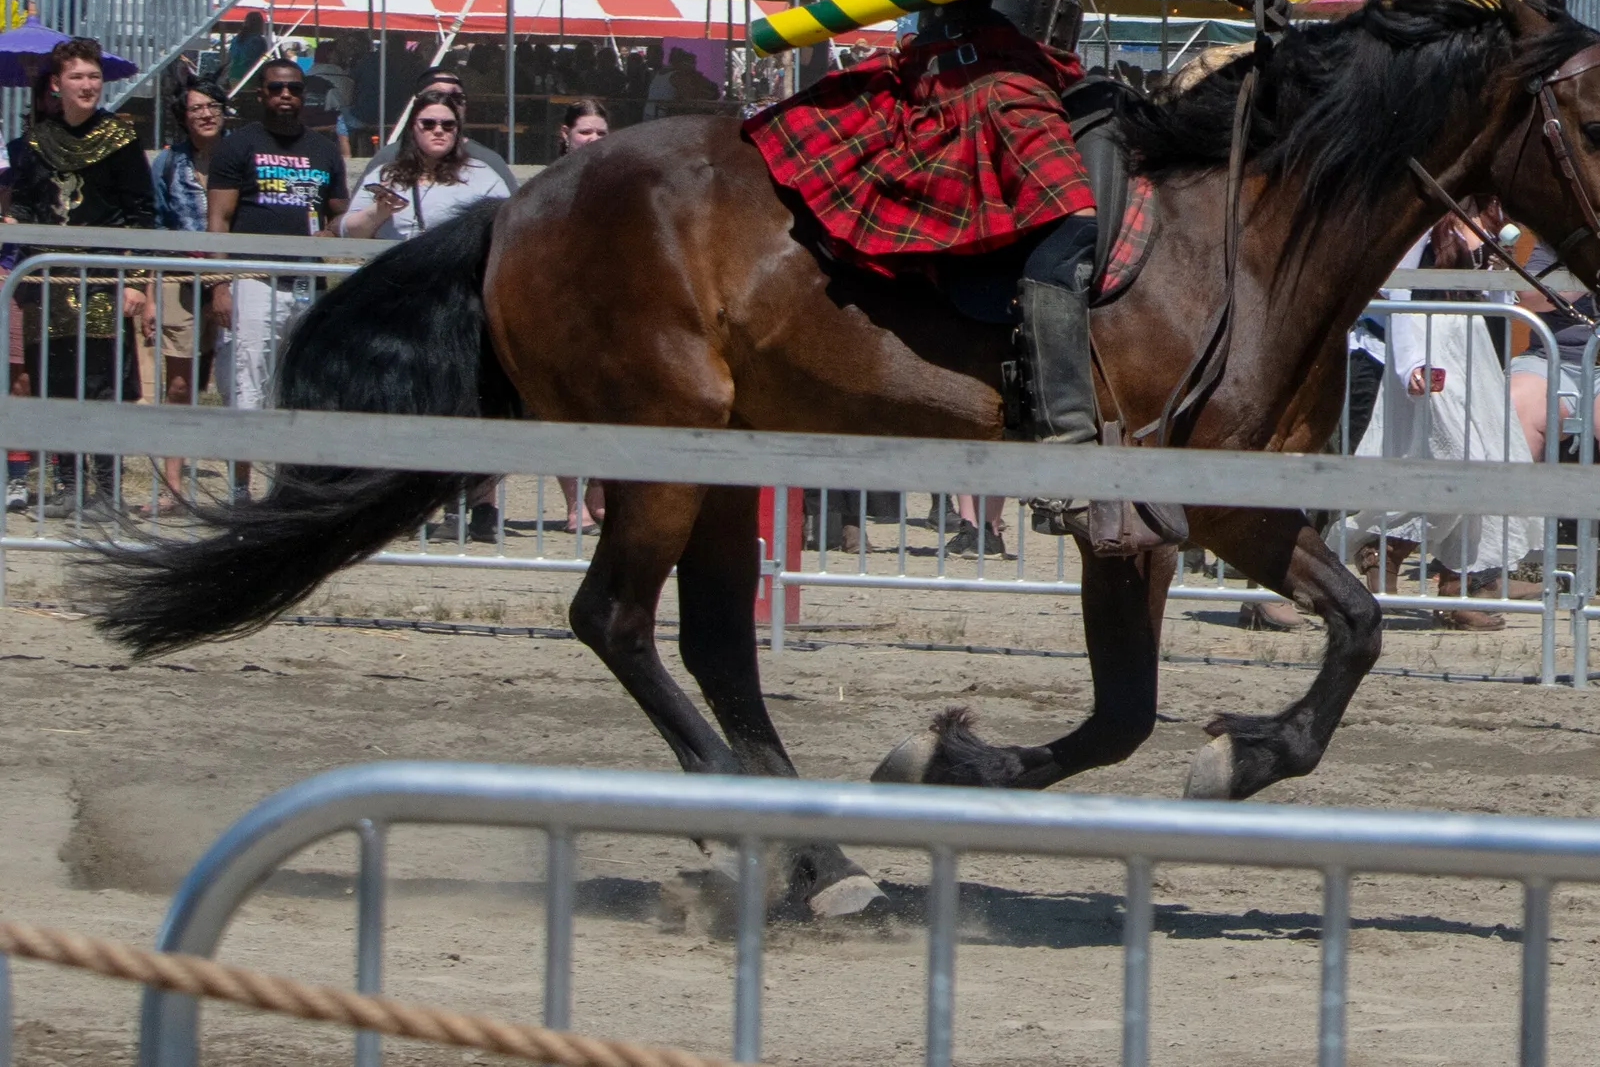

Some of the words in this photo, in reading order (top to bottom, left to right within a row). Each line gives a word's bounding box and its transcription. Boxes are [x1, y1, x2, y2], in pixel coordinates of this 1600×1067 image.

[255, 153, 311, 168] HUSTLE
[256, 166, 330, 185] THROUGH
[256, 179, 287, 191] THE
